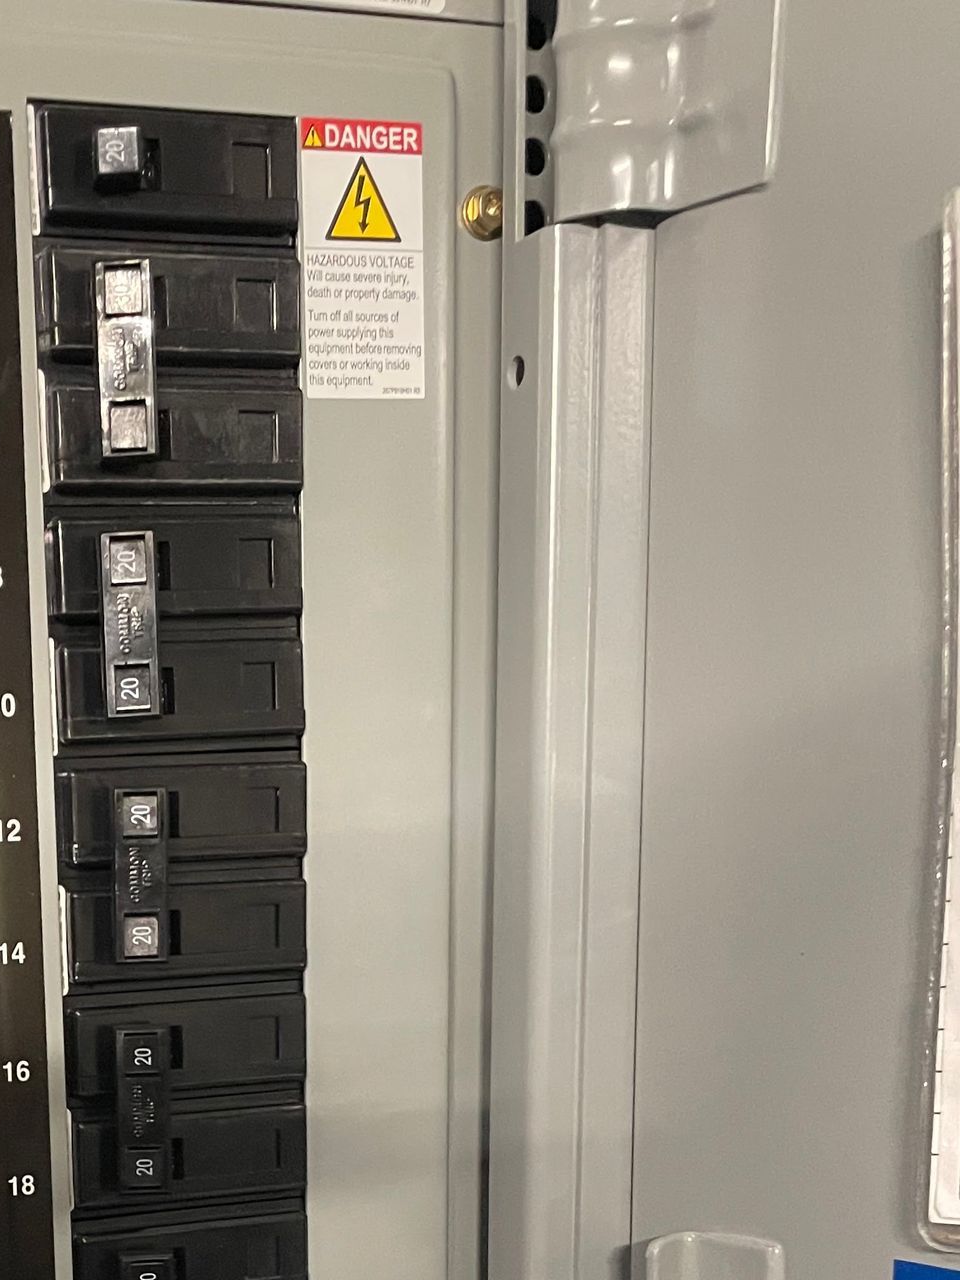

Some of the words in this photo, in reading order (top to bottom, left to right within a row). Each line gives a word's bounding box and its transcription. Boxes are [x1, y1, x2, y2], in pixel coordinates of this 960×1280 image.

[324, 123, 418, 151] DANGER
[105, 140, 125, 163] 20
[307, 254, 367, 267] HAZARDOUS
[369, 256, 414, 269] VOLTAGE
[307, 270, 323, 281] Will
[325, 272, 350, 282] cause
[353, 273, 381, 283] severe
[307, 287, 331, 298] death
[334, 289, 342, 298] or
[345, 289, 380, 301] property
[330, 310, 341, 321] off
[343, 310, 353, 321] all
[355, 313, 388, 322] sources
[391, 312, 399, 322] of
[309, 328, 334, 339] power
[337, 327, 377, 341] supplying
[379, 328, 394, 338] this
[309, 343, 353, 356] equipment
[356, 343, 382, 354] before
[384, 345, 421, 357] removing
[309, 360, 337, 369] covers
[340, 360, 348, 369] or
[351, 358, 383, 373] working
[386, 359, 409, 370] inside
[309, 375, 324, 385] this
[117, 549, 136, 574] 20
[120, 677, 140, 701] 20
[130, 804, 151, 825] 20
[132, 925, 152, 946] 20
[133, 1047, 152, 1067] 20
[2, 1060, 31, 1083] 16
[135, 1157, 153, 1177] 20
[7, 1174, 35, 1197] 18
